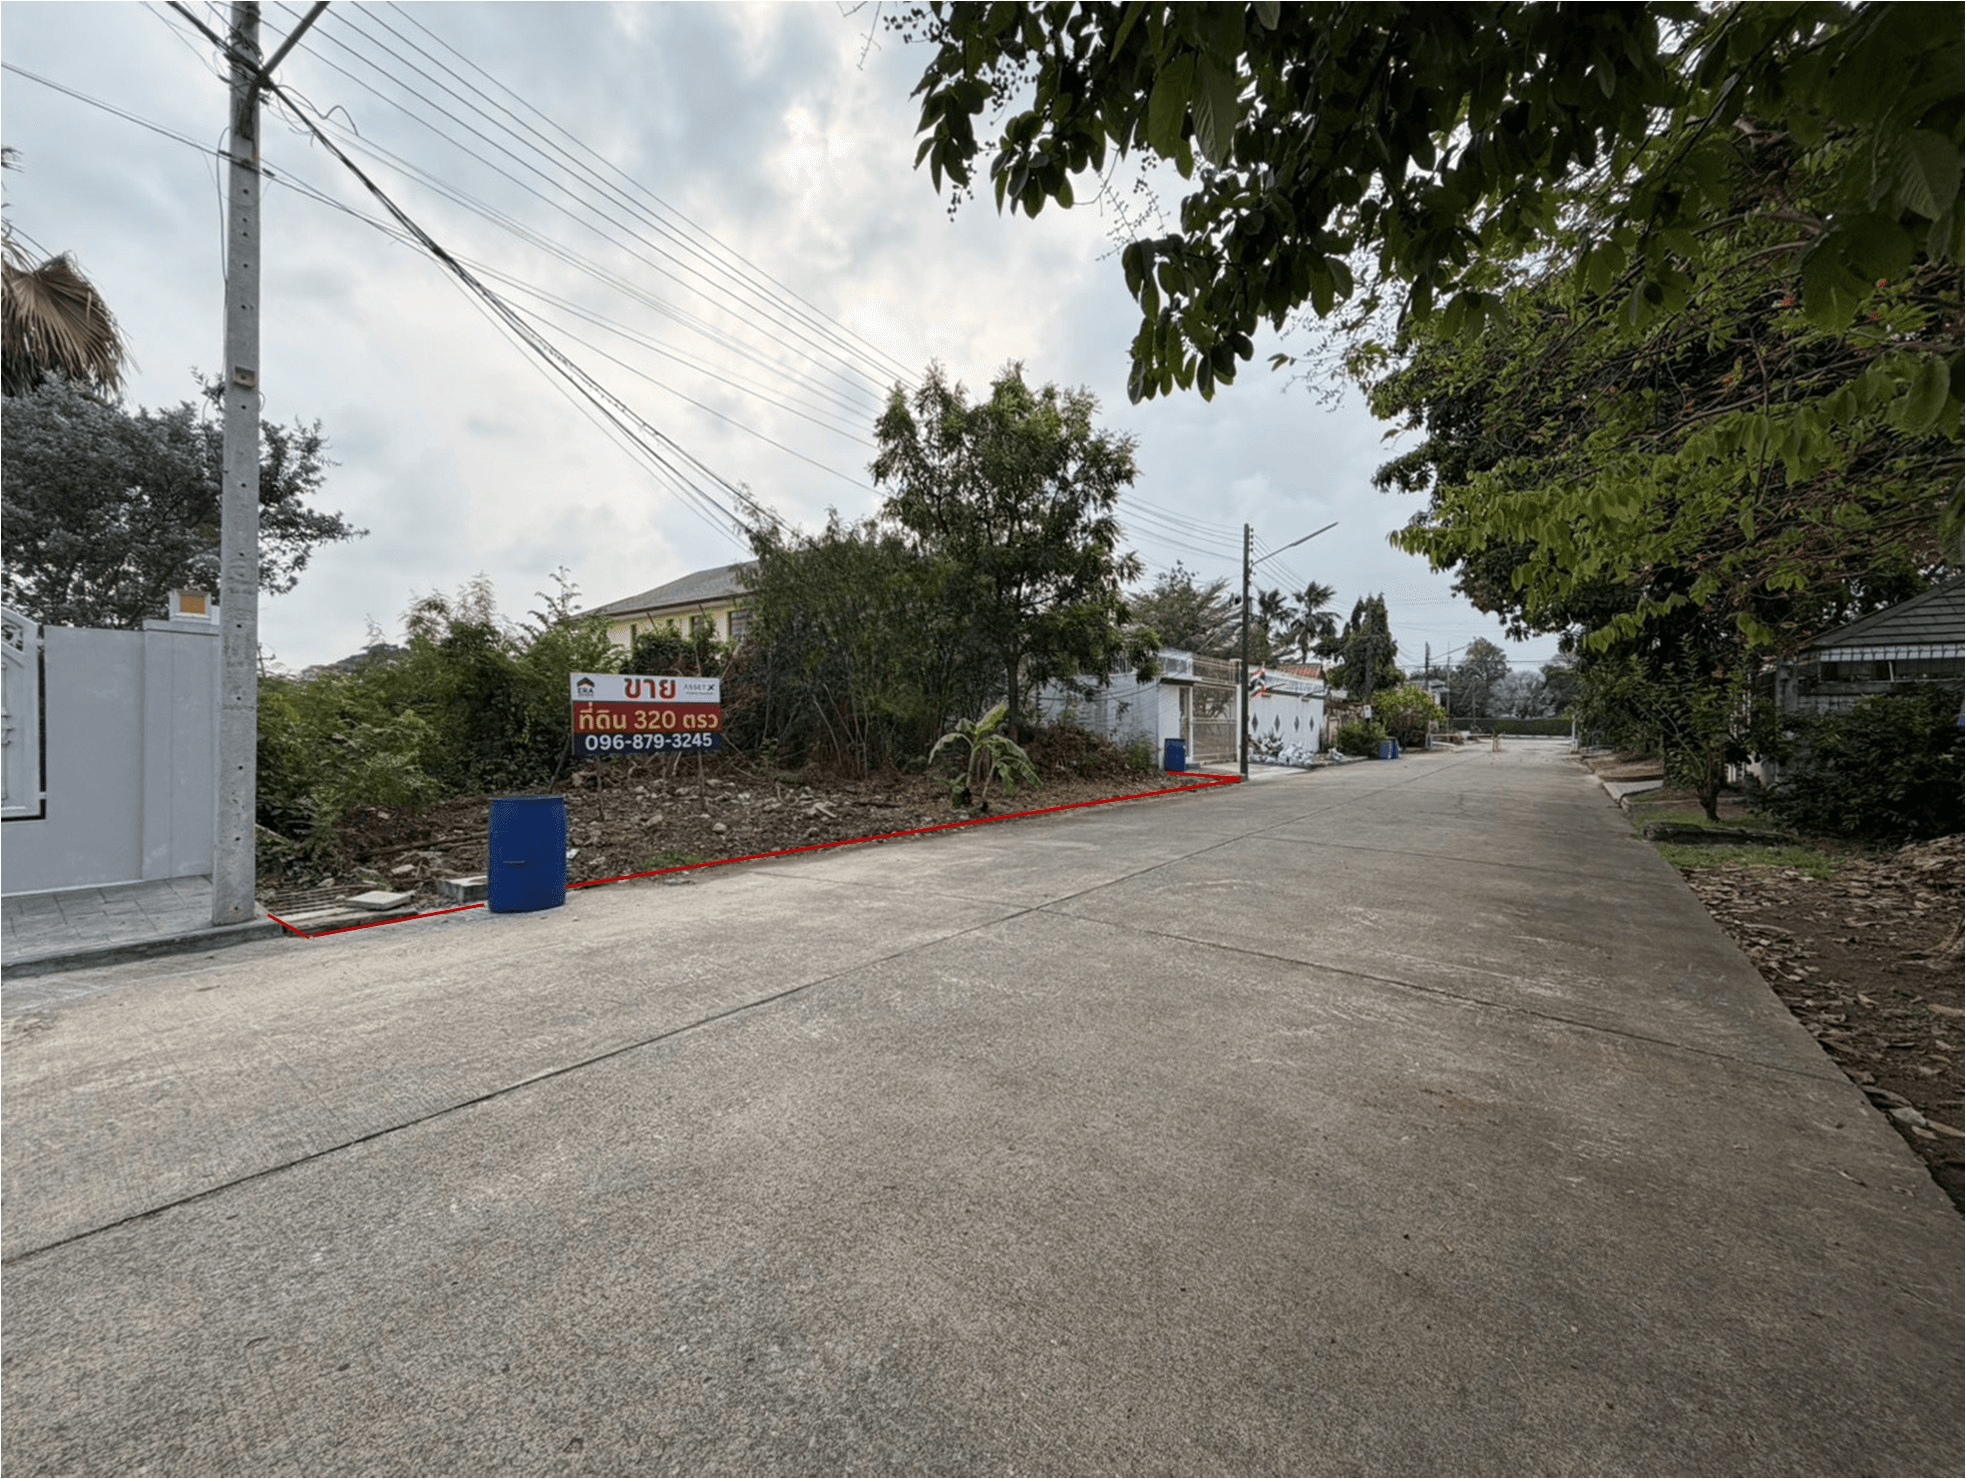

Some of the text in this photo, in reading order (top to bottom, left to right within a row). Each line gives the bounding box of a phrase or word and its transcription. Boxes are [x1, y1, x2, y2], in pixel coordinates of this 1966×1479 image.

[624, 677, 678, 701] ขาย
[579, 701, 718, 730] ที่ดิน 320 ตรว
[585, 733, 712, 751] 096-879-3245
